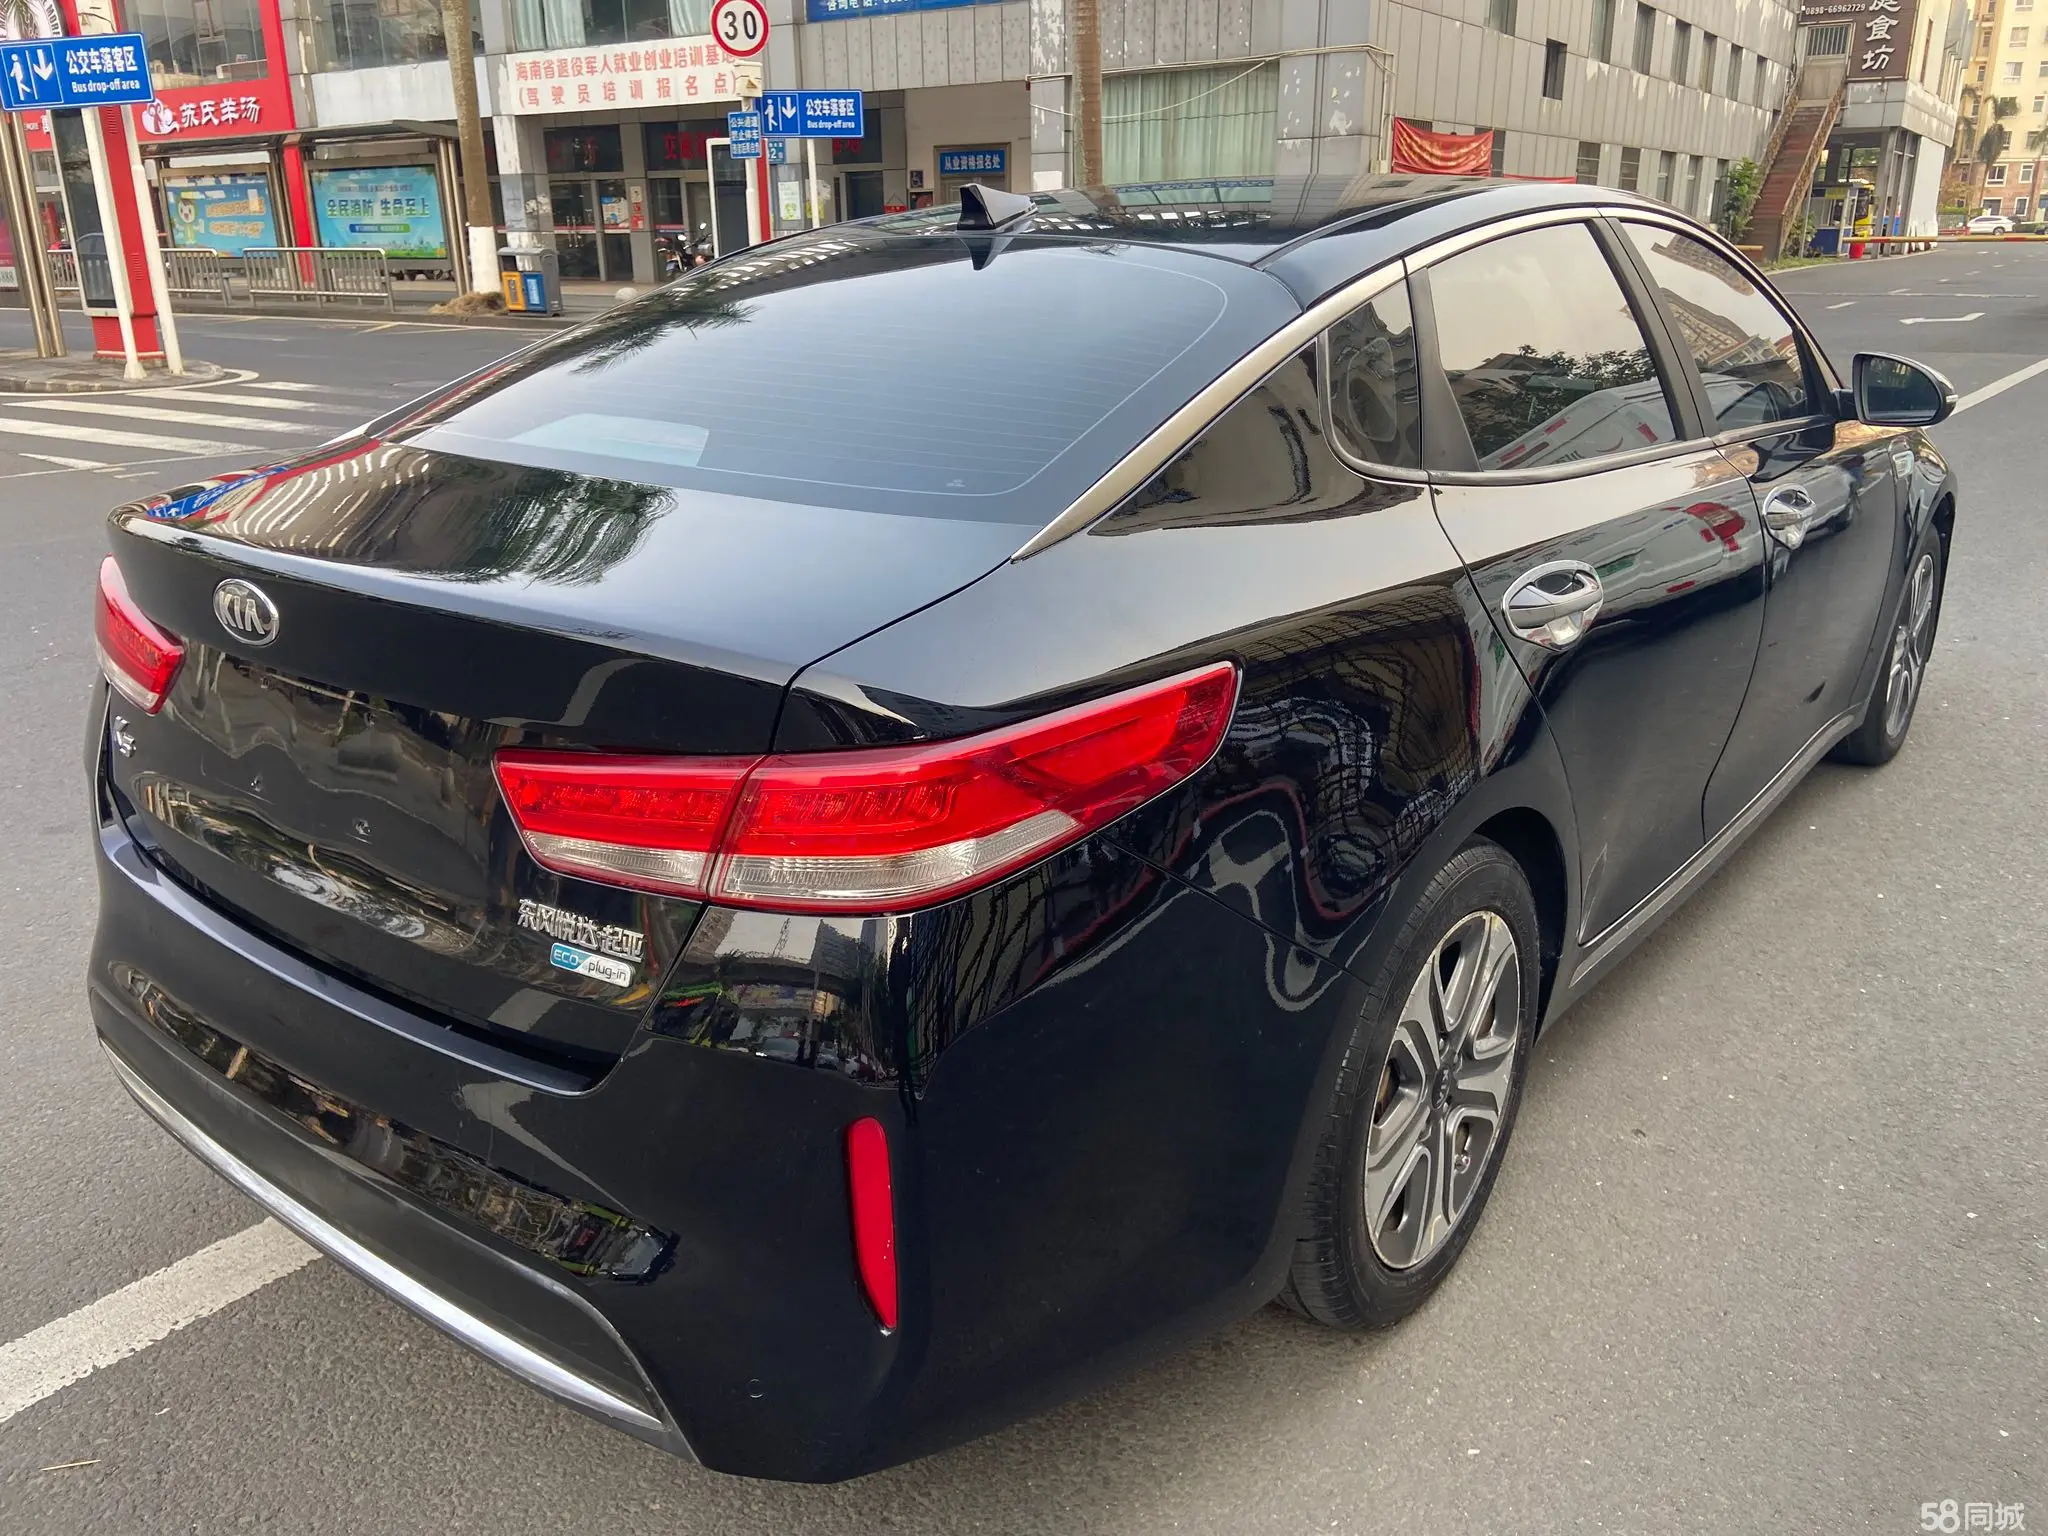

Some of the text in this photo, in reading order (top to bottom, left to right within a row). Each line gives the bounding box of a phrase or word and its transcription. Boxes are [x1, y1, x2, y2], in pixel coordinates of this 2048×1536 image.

[1806, 4, 1865, 15] 0898-66962729
[724, 11, 757, 40] 30
[66, 45, 138, 75] 公交车落客区
[72, 78, 140, 94] Bus drop-off area
[180, 97, 261, 128] 苏氏羊汤
[806, 98, 856, 117] 公交车落客区
[807, 120, 818, 129] Bus
[327, 198, 430, 218] 全民消防 生命至上
[218, 590, 267, 636] KIA
[517, 898, 646, 963] 东风悦达起亚
[553, 949, 628, 982] ECO plug-in
